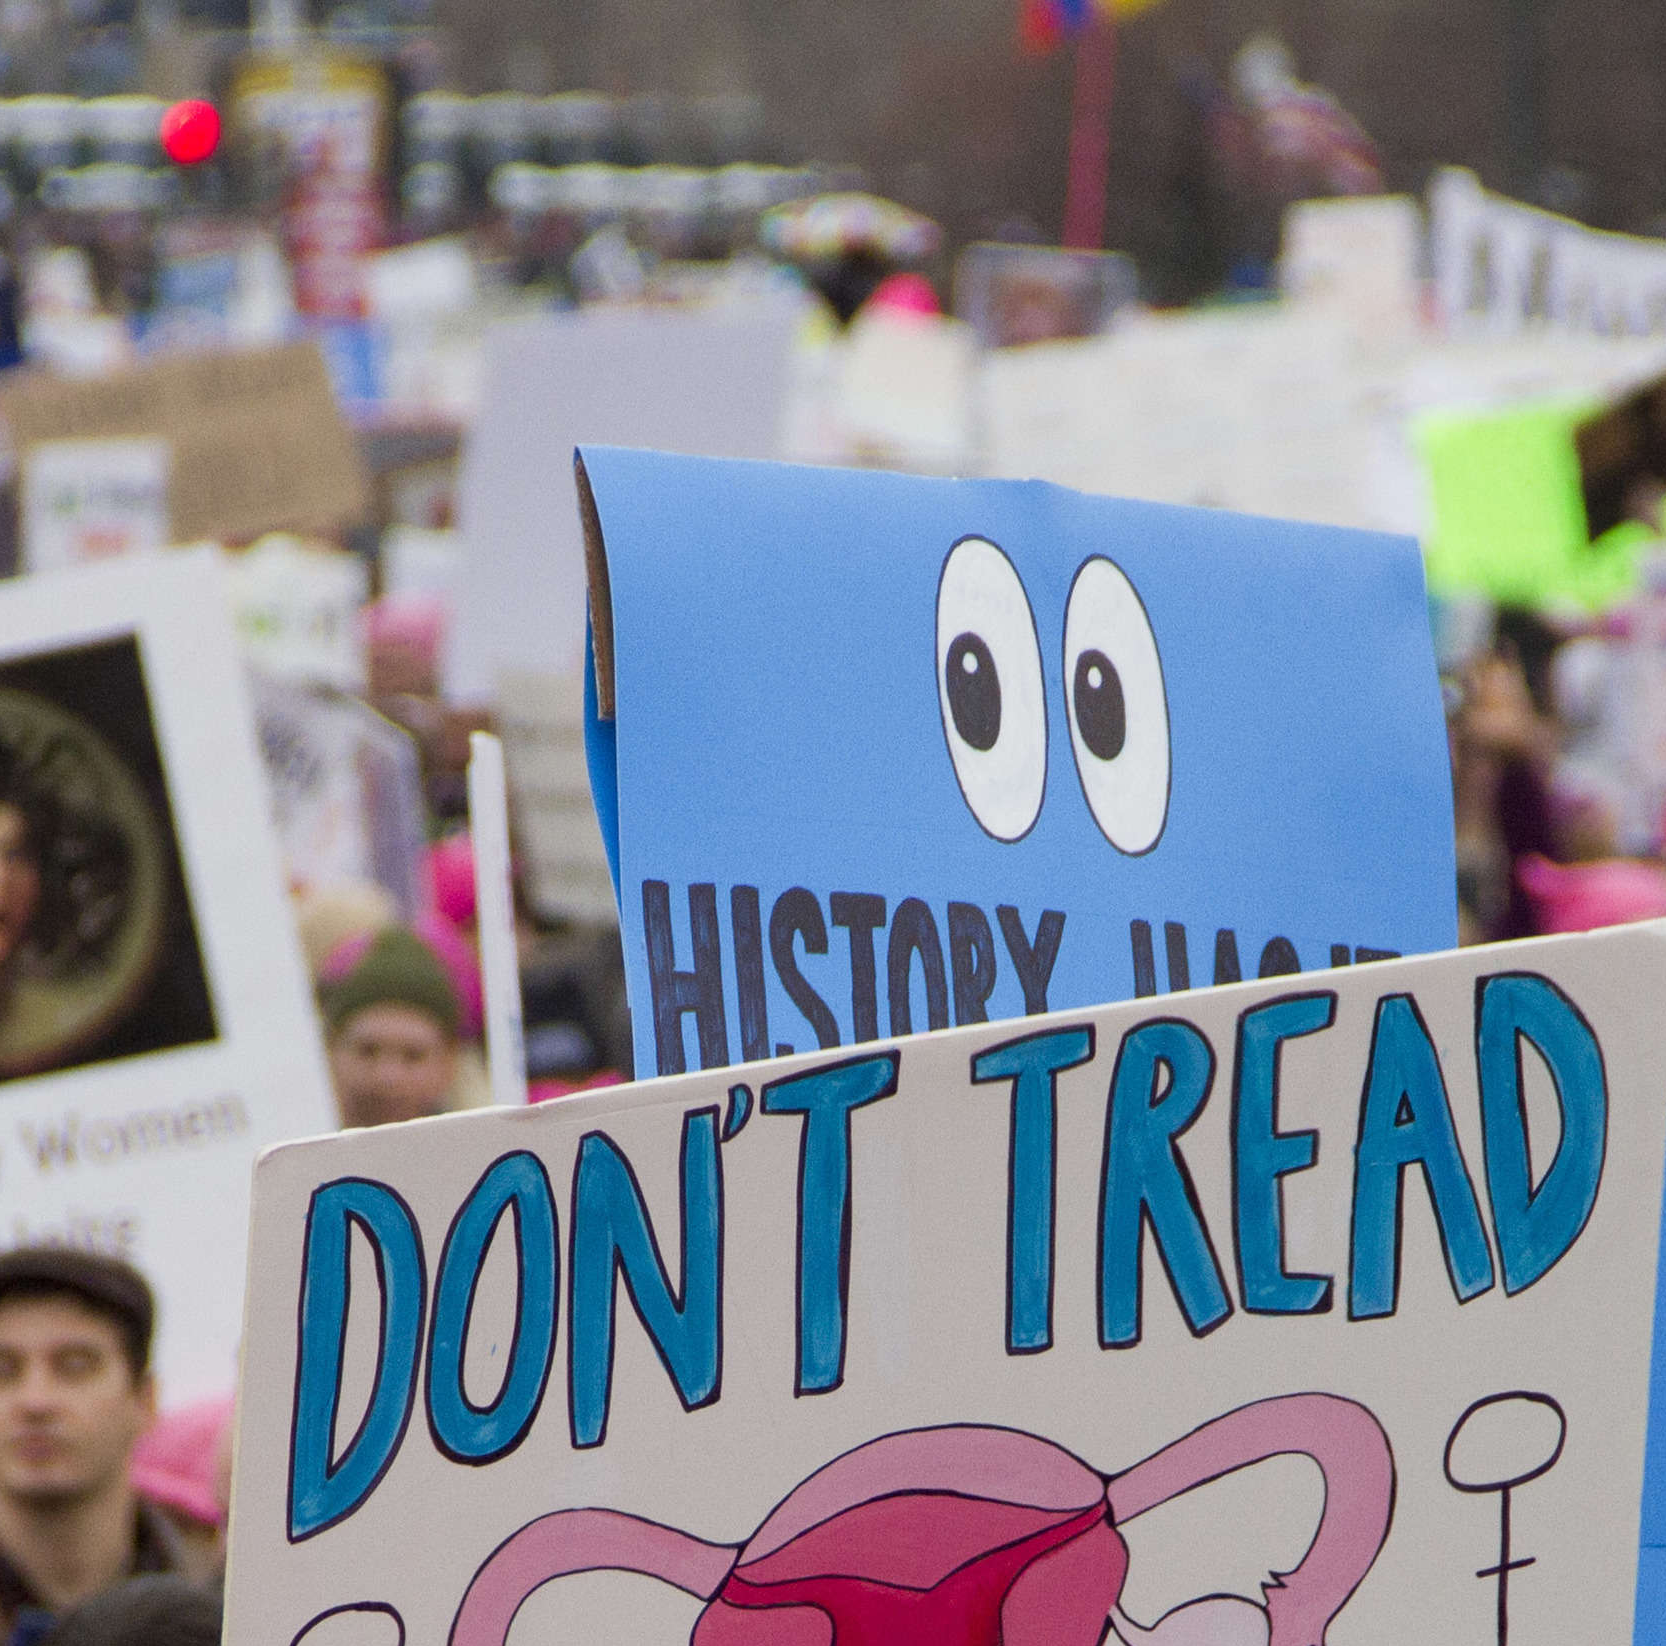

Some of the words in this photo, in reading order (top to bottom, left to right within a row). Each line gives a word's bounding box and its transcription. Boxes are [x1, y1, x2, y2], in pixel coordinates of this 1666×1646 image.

[642, 879, 1067, 1078] HISTORY
[18, 1088, 251, 1172] Women
[287, 1050, 900, 1544] DON'T
[970, 971, 1610, 1355] TREAD
